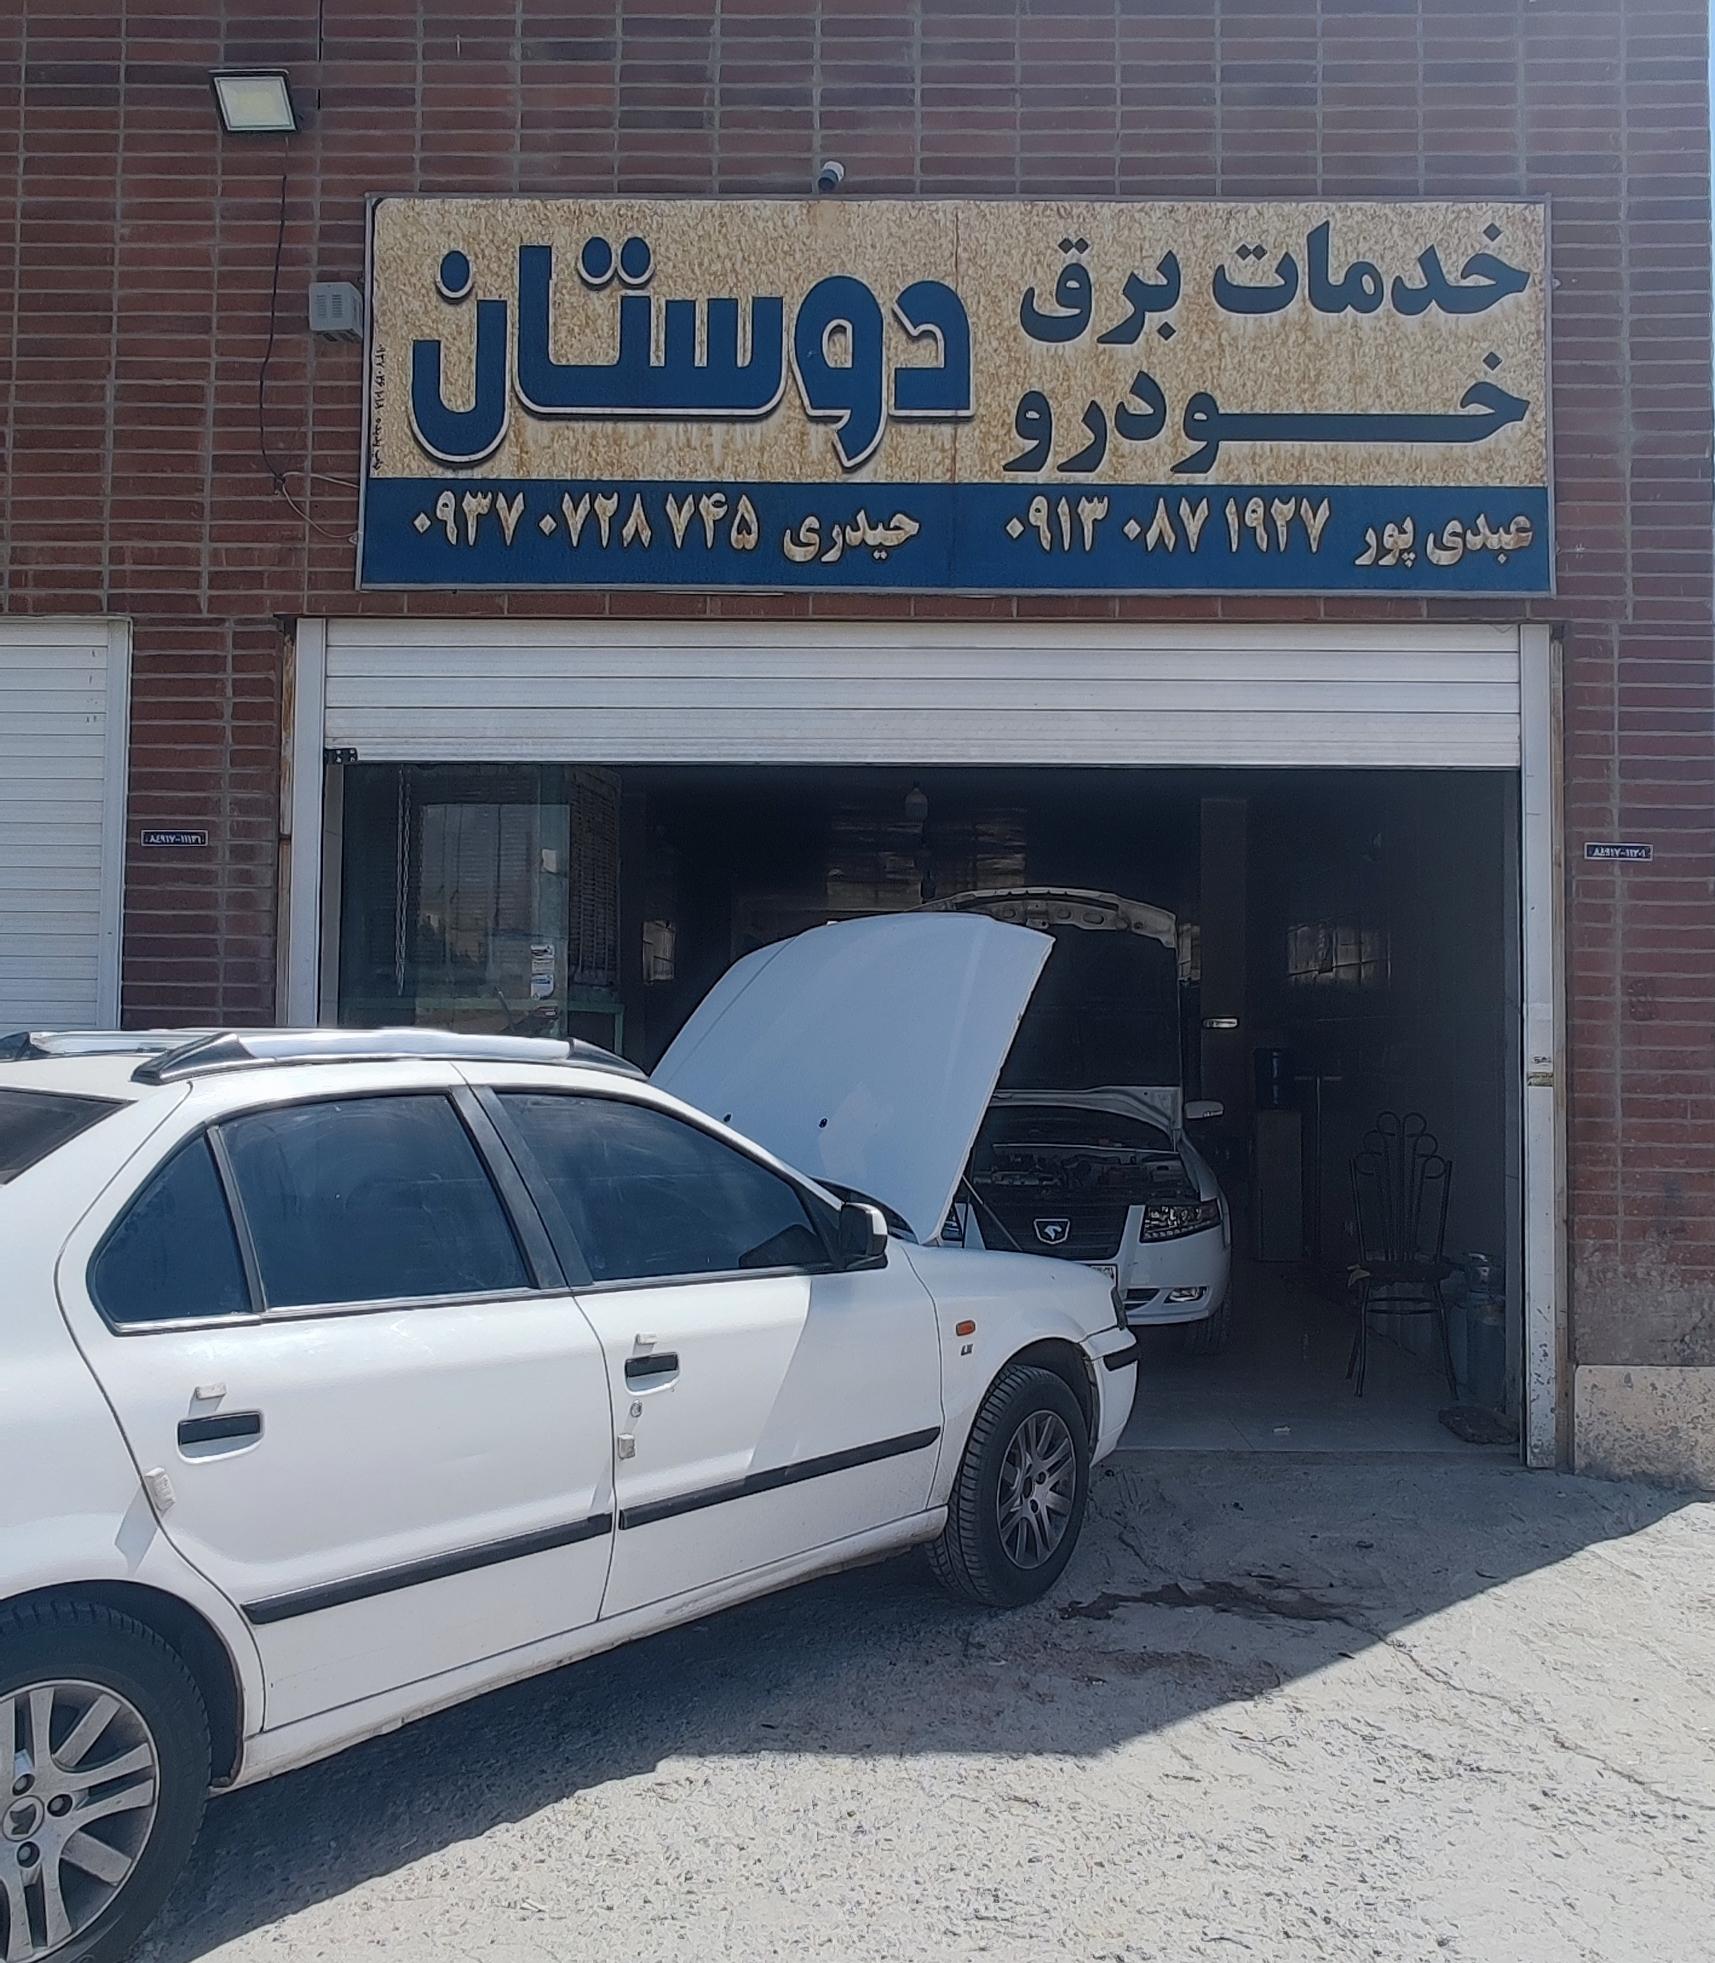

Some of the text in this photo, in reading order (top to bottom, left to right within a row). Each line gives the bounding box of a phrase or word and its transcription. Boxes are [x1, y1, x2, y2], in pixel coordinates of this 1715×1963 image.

[1019, 220, 1531, 345] خدمات برق
[410, 236, 972, 468] دوستان
[1001, 351, 1531, 474] خودرو
[413, 490, 920, 563] حیدری ۰۹۳۷ ۰۷۲۸ ۷۴۵
[1005, 495, 1534, 568] عبدی پور ۰۹۱۳ ۰۸۷ ۱۹۲۷
